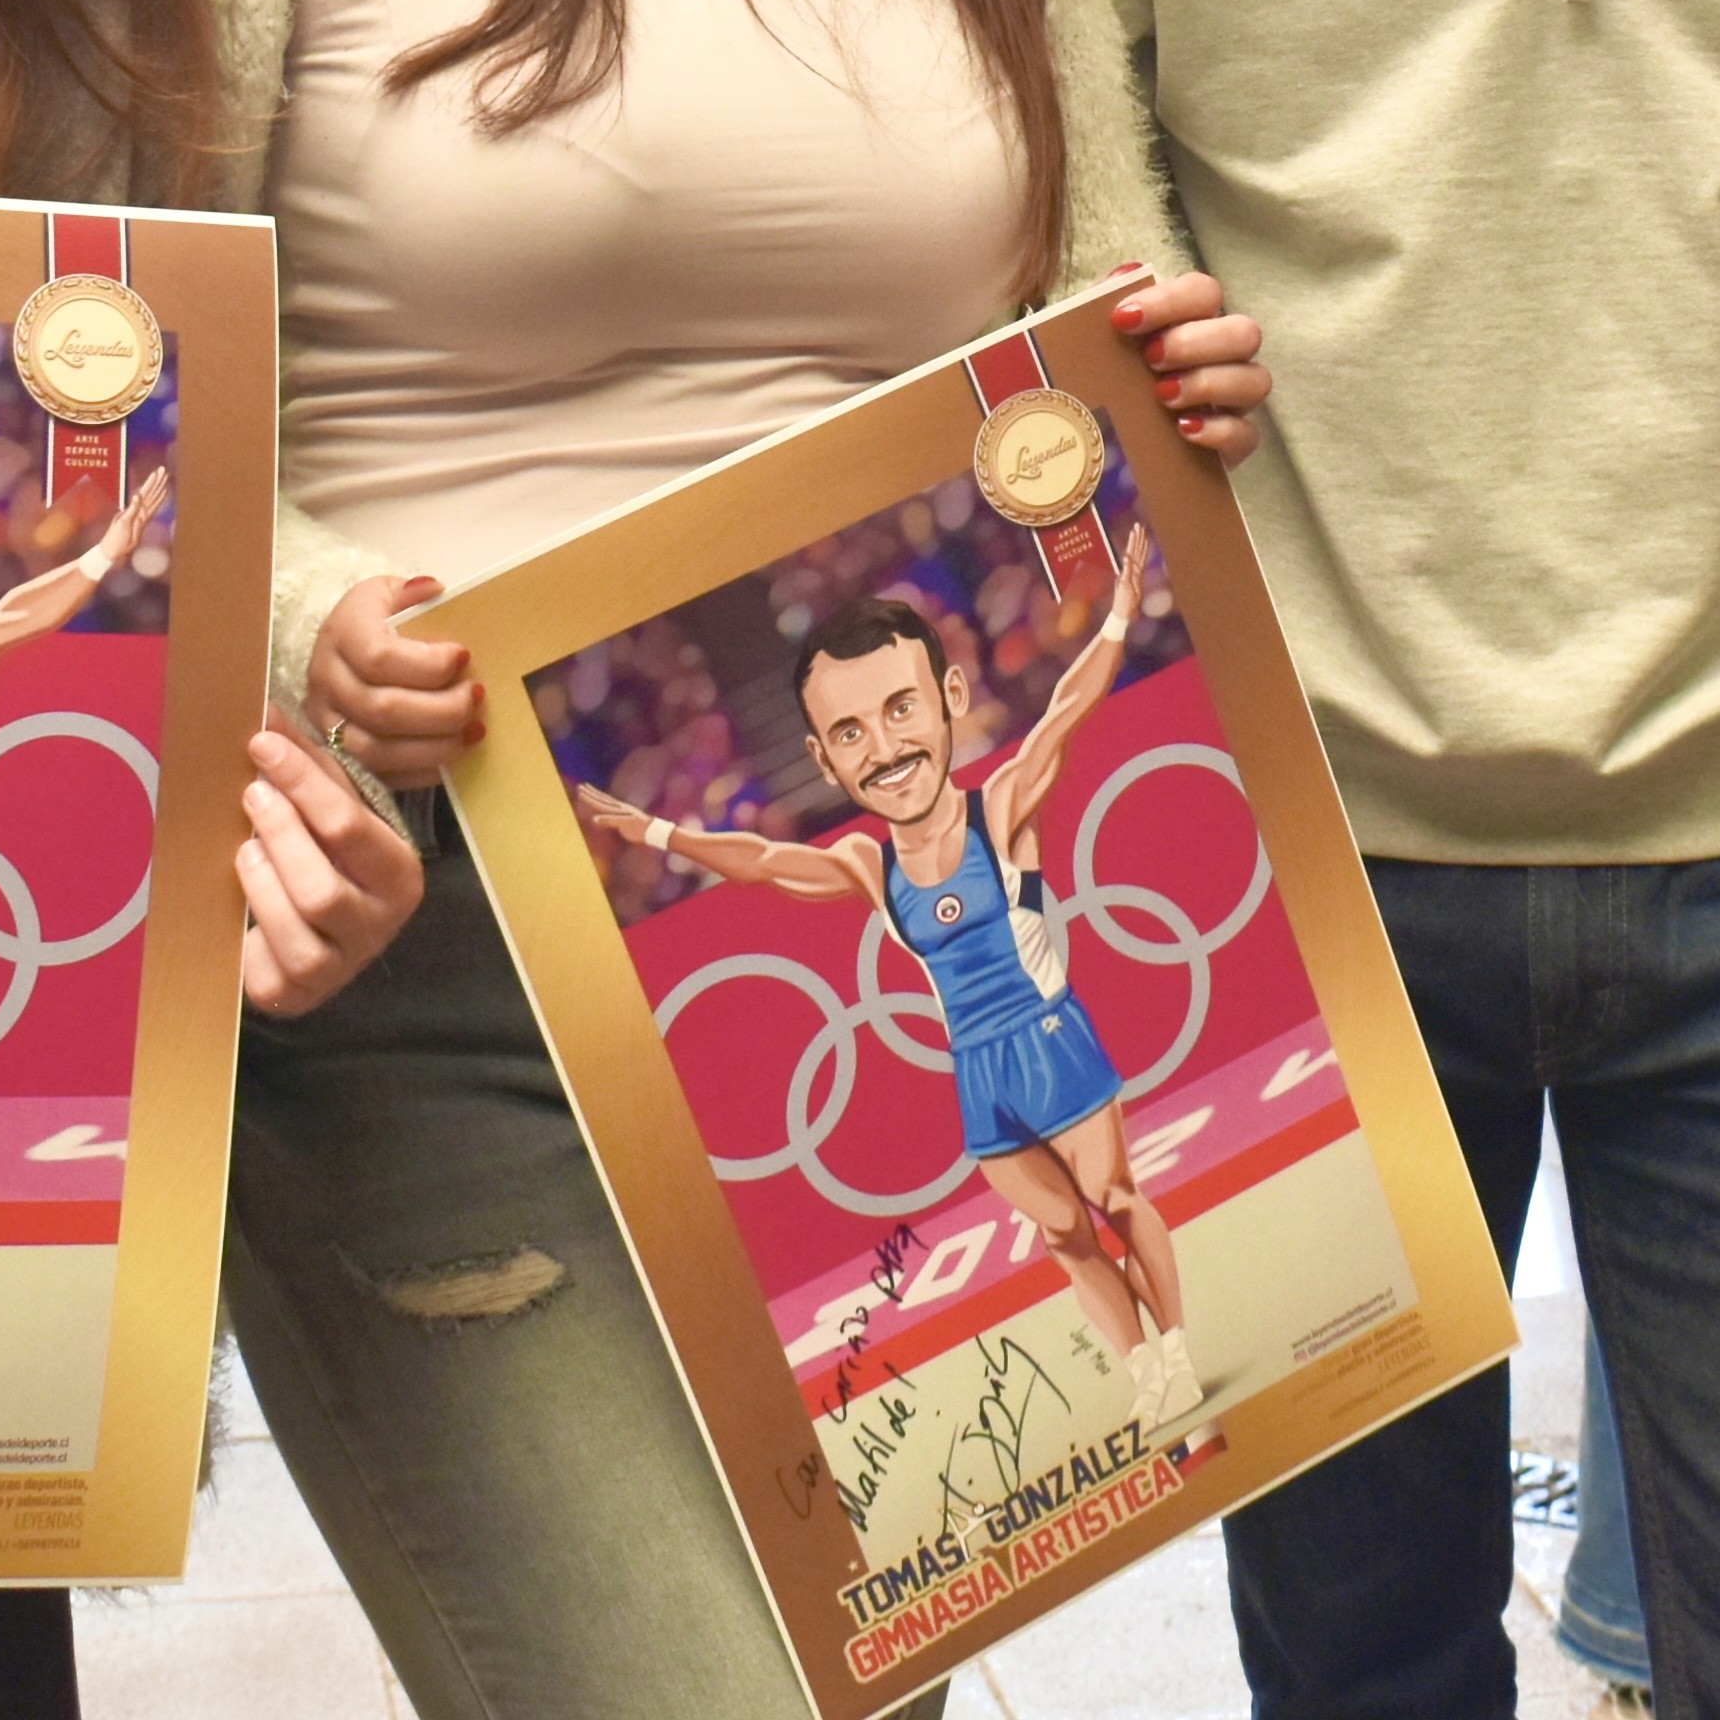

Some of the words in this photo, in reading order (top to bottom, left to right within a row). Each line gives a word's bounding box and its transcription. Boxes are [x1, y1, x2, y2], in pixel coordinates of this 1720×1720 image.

[44, 329, 134, 370] Leyendas
[65, 446, 108, 456] DEPORTE
[75, 435, 99, 444] ARTE
[1006, 434, 1077, 485] Leyendas
[65, 458, 109, 467] CULTURA
[844, 1534, 967, 1624] TOMÁS
[984, 1419, 1151, 1544] GONZÁLEZ
[849, 1560, 1010, 1680] GIMNASIA
[1013, 1456, 1180, 1582] ARTÍSTICA
